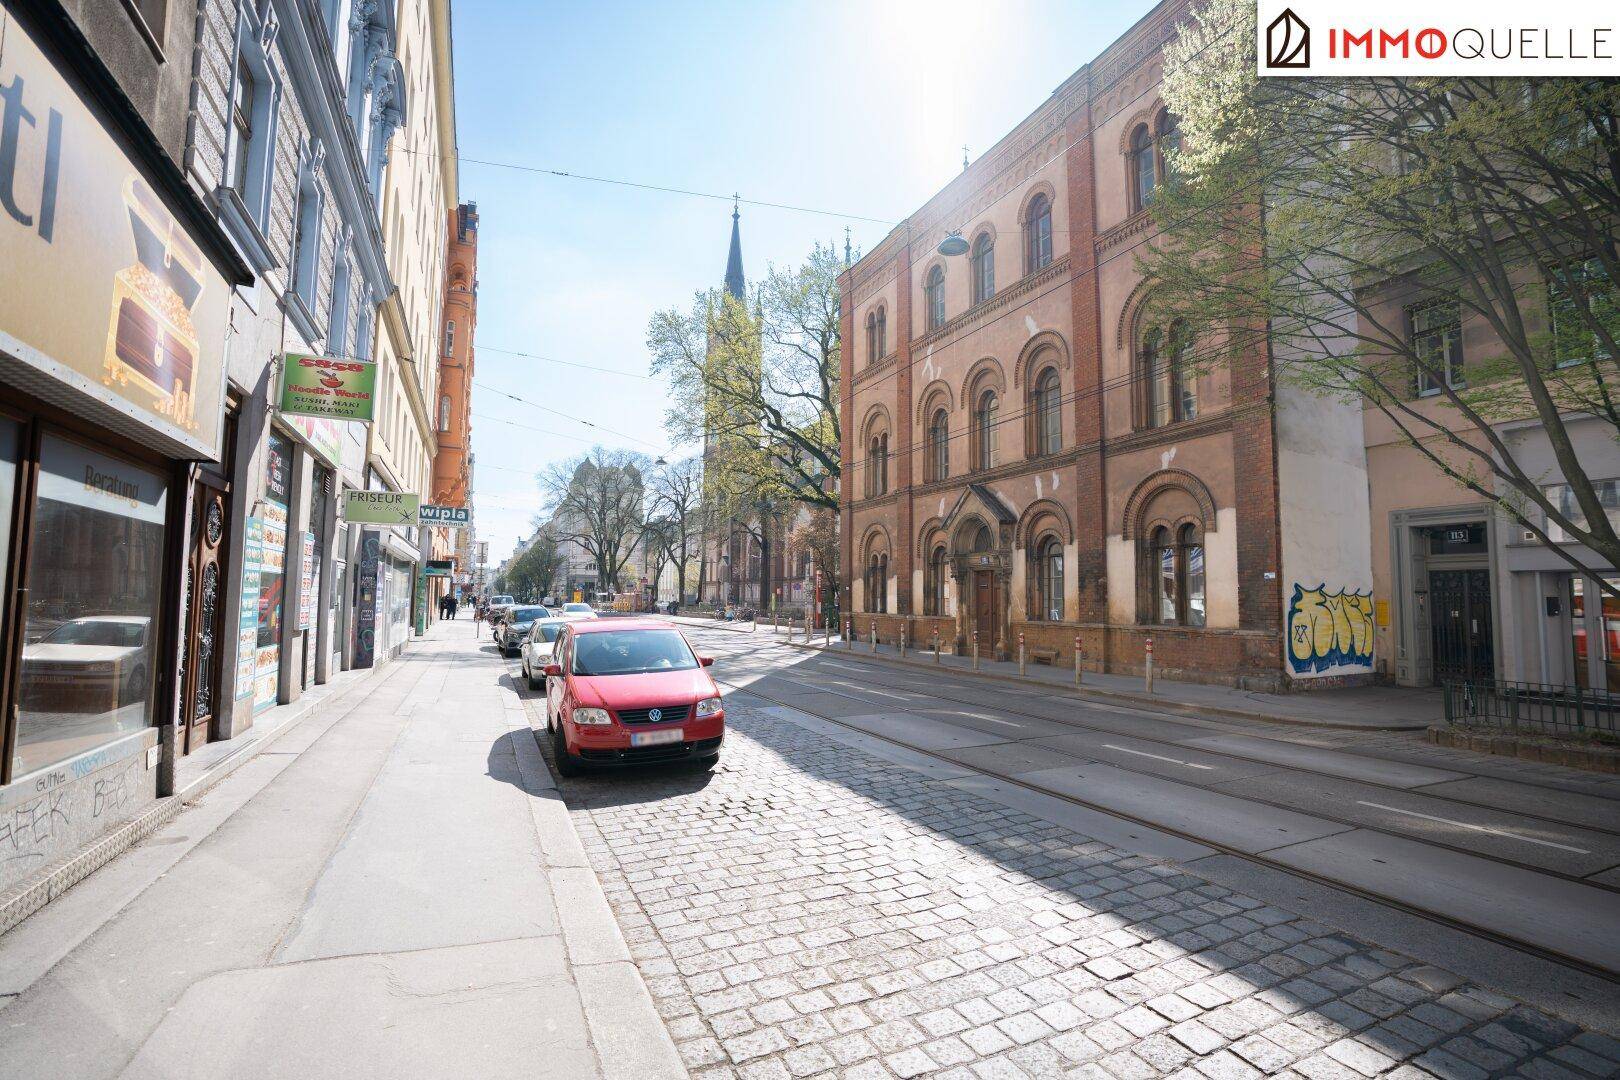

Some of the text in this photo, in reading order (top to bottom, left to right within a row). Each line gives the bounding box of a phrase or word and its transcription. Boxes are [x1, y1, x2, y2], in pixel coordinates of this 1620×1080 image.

[288, 384, 370, 400] Noodle World
[332, 399, 360, 408] MAKI
[306, 405, 354, 415] TAKEWAY
[84, 464, 139, 508] Beratung
[350, 492, 402, 504] FRISEUR
[420, 507, 466, 521] wipla
[420, 519, 465, 527] zahntechnik
